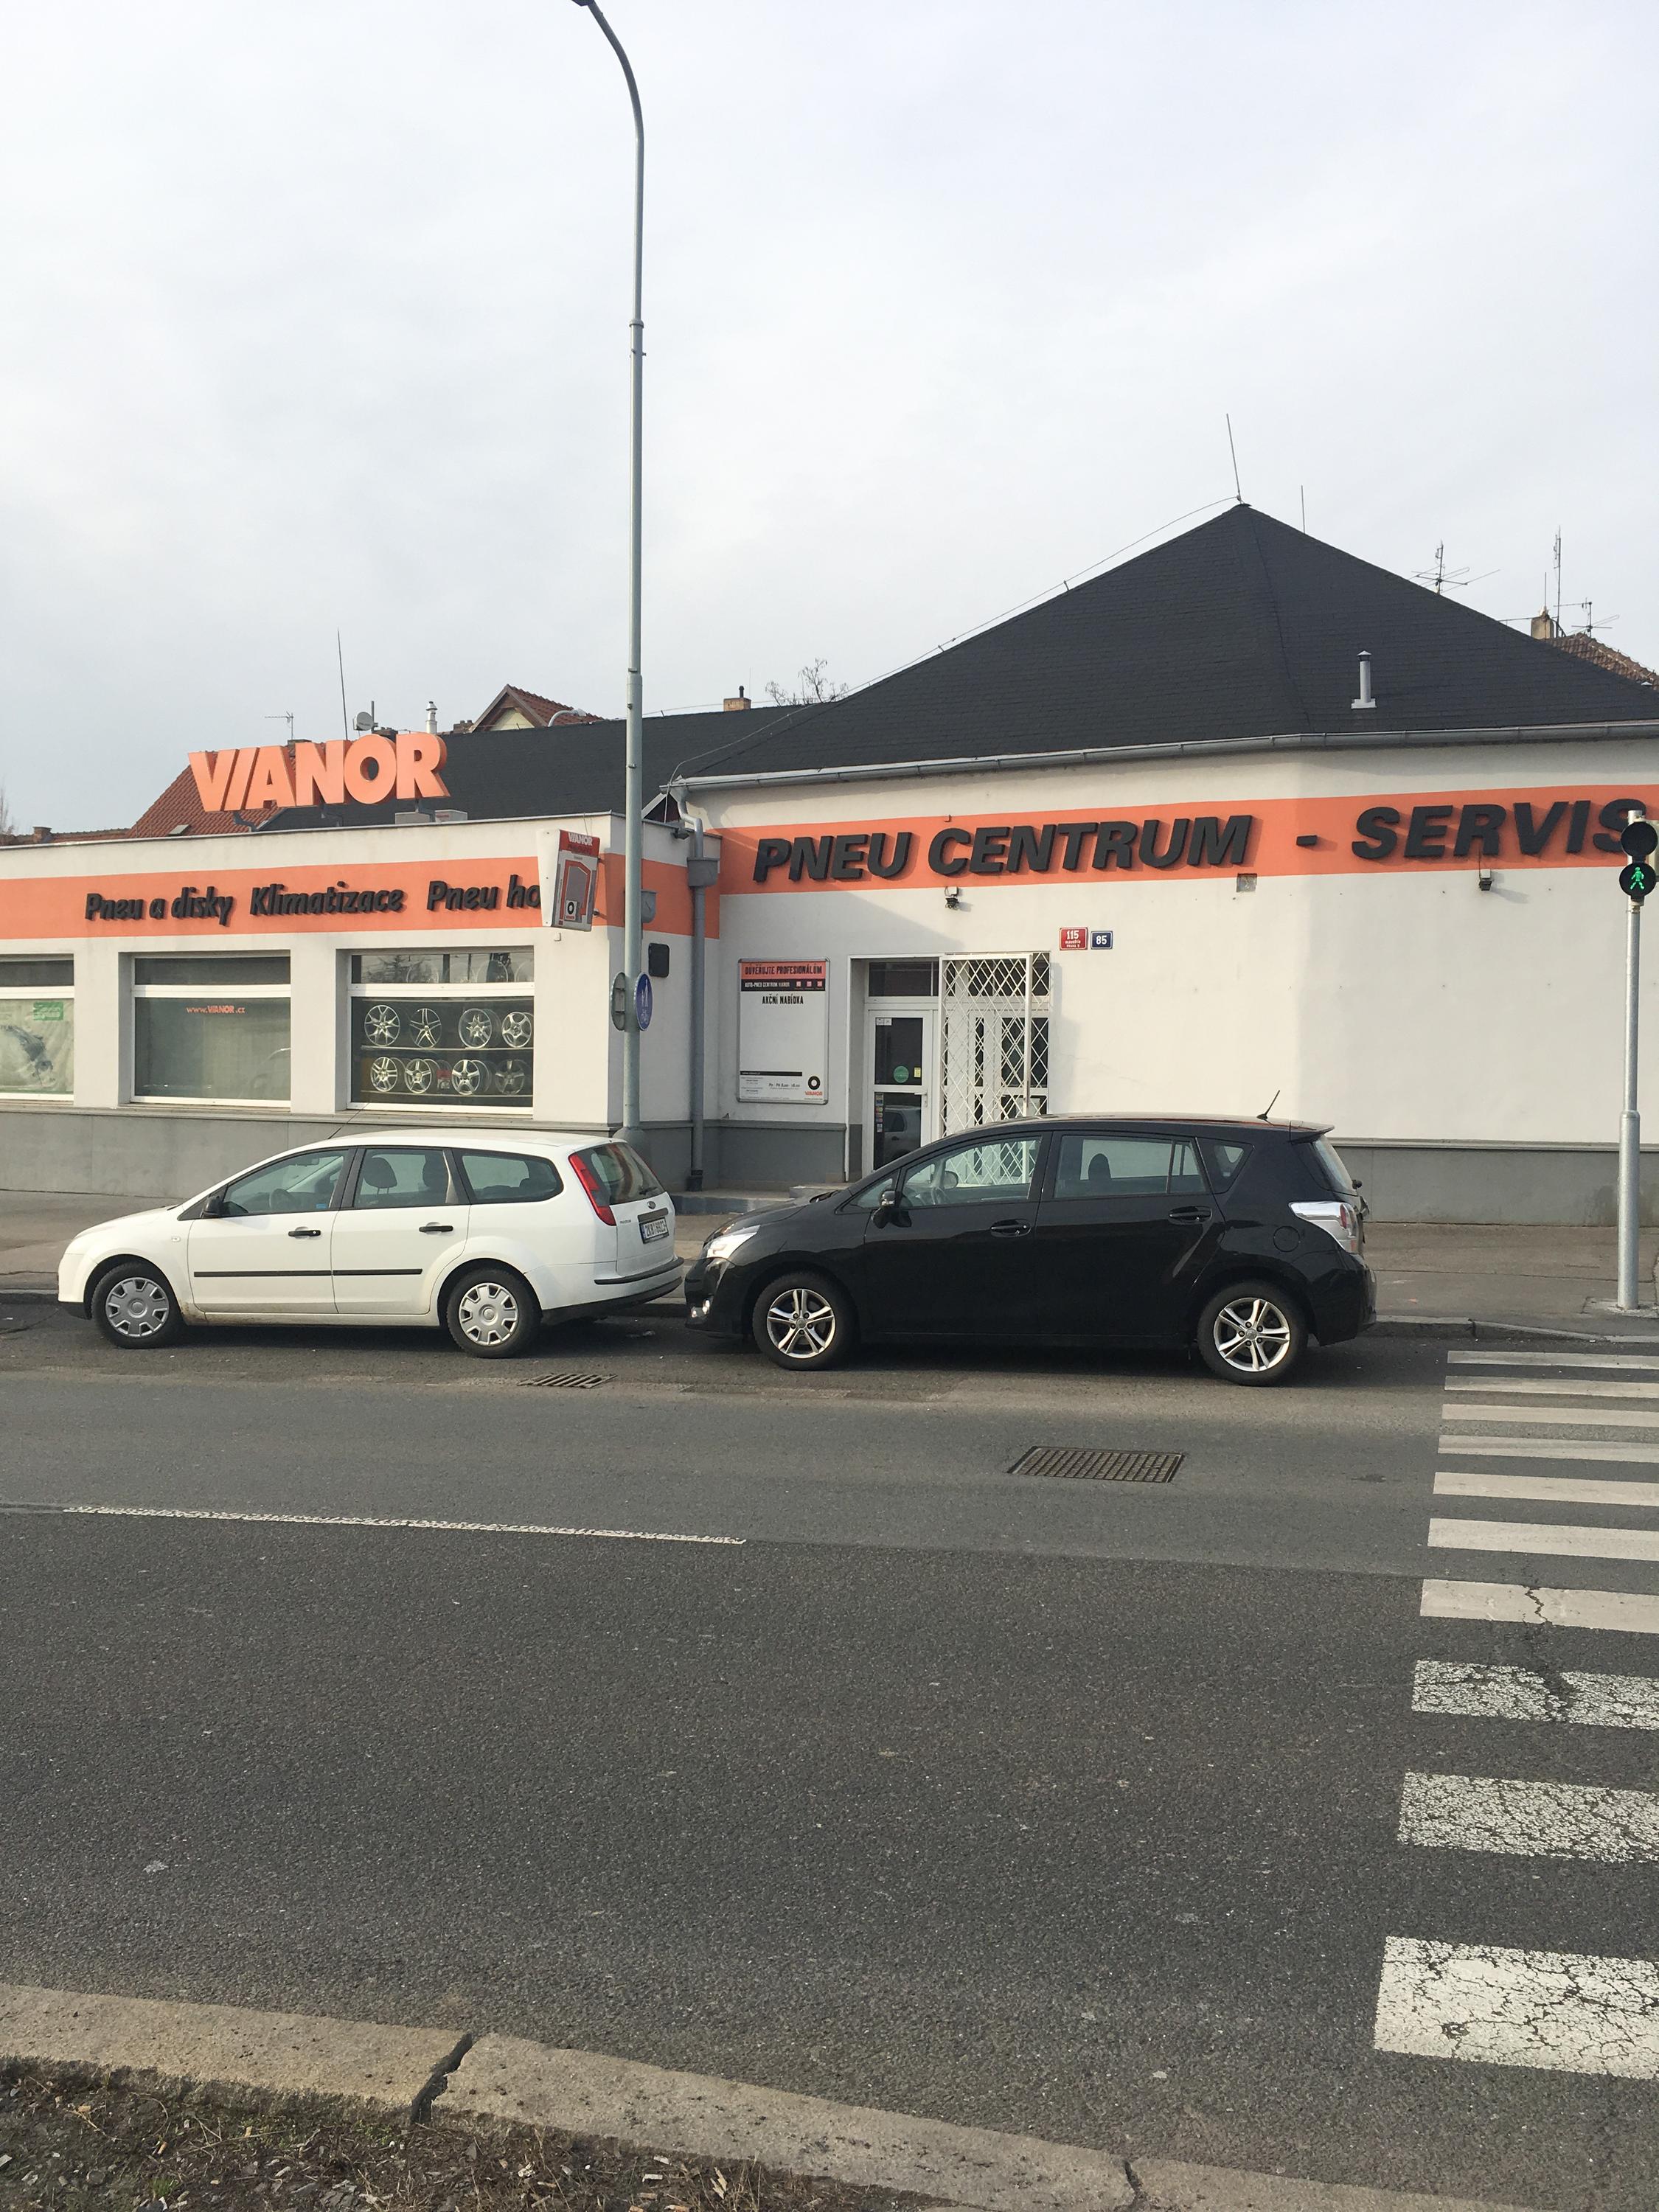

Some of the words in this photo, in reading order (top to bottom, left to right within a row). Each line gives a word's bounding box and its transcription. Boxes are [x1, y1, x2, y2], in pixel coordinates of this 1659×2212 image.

[188, 731, 451, 812] VIANOR
[568, 832, 593, 846] VIANOR
[753, 832, 912, 883] PNEU
[928, 815, 1253, 876] CENTRUM
[85, 893, 144, 920] Pneu
[149, 898, 167, 919] a
[171, 886, 234, 926] disky
[250, 880, 405, 915] Klimatizace
[426, 880, 500, 911] Pneu
[1066, 930, 1079, 939] 115
[1096, 935, 1107, 945] 85
[762, 993, 778, 1004] AKČNÍ
[779, 993, 804, 1004] NABÍDKA
